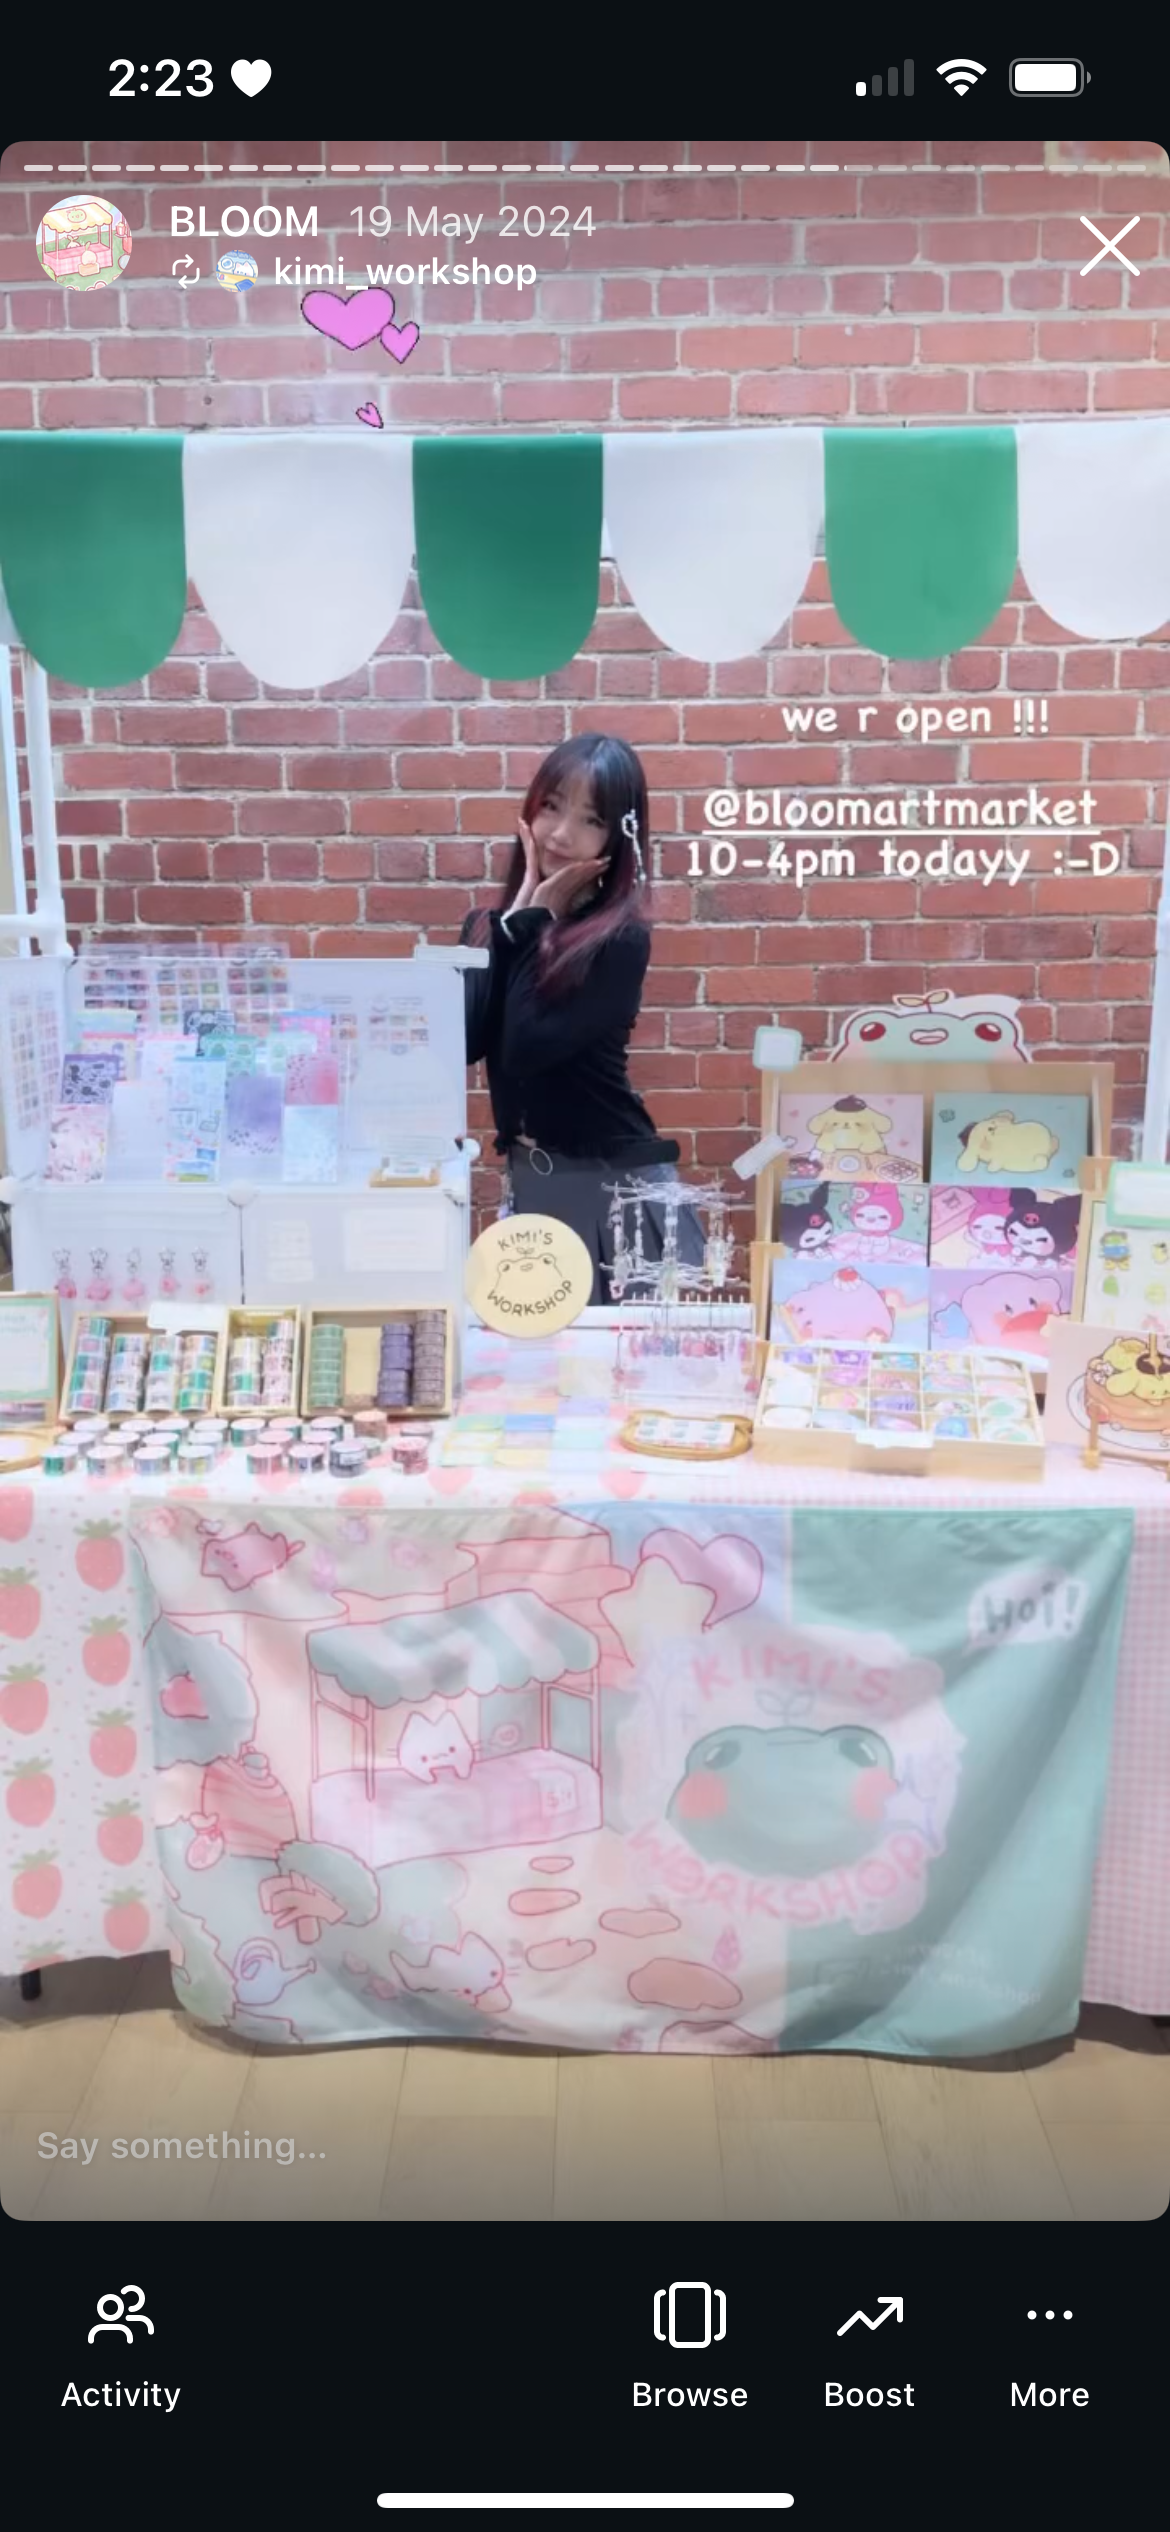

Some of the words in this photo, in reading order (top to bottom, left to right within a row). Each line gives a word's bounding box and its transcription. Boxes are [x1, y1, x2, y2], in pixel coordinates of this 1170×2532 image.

[498, 1229, 554, 1251] KIMI'S
[487, 1279, 573, 1317] WORKSHOP
[691, 1643, 894, 1703] KIMI'S
[628, 1820, 927, 1923] WORKSHOP
